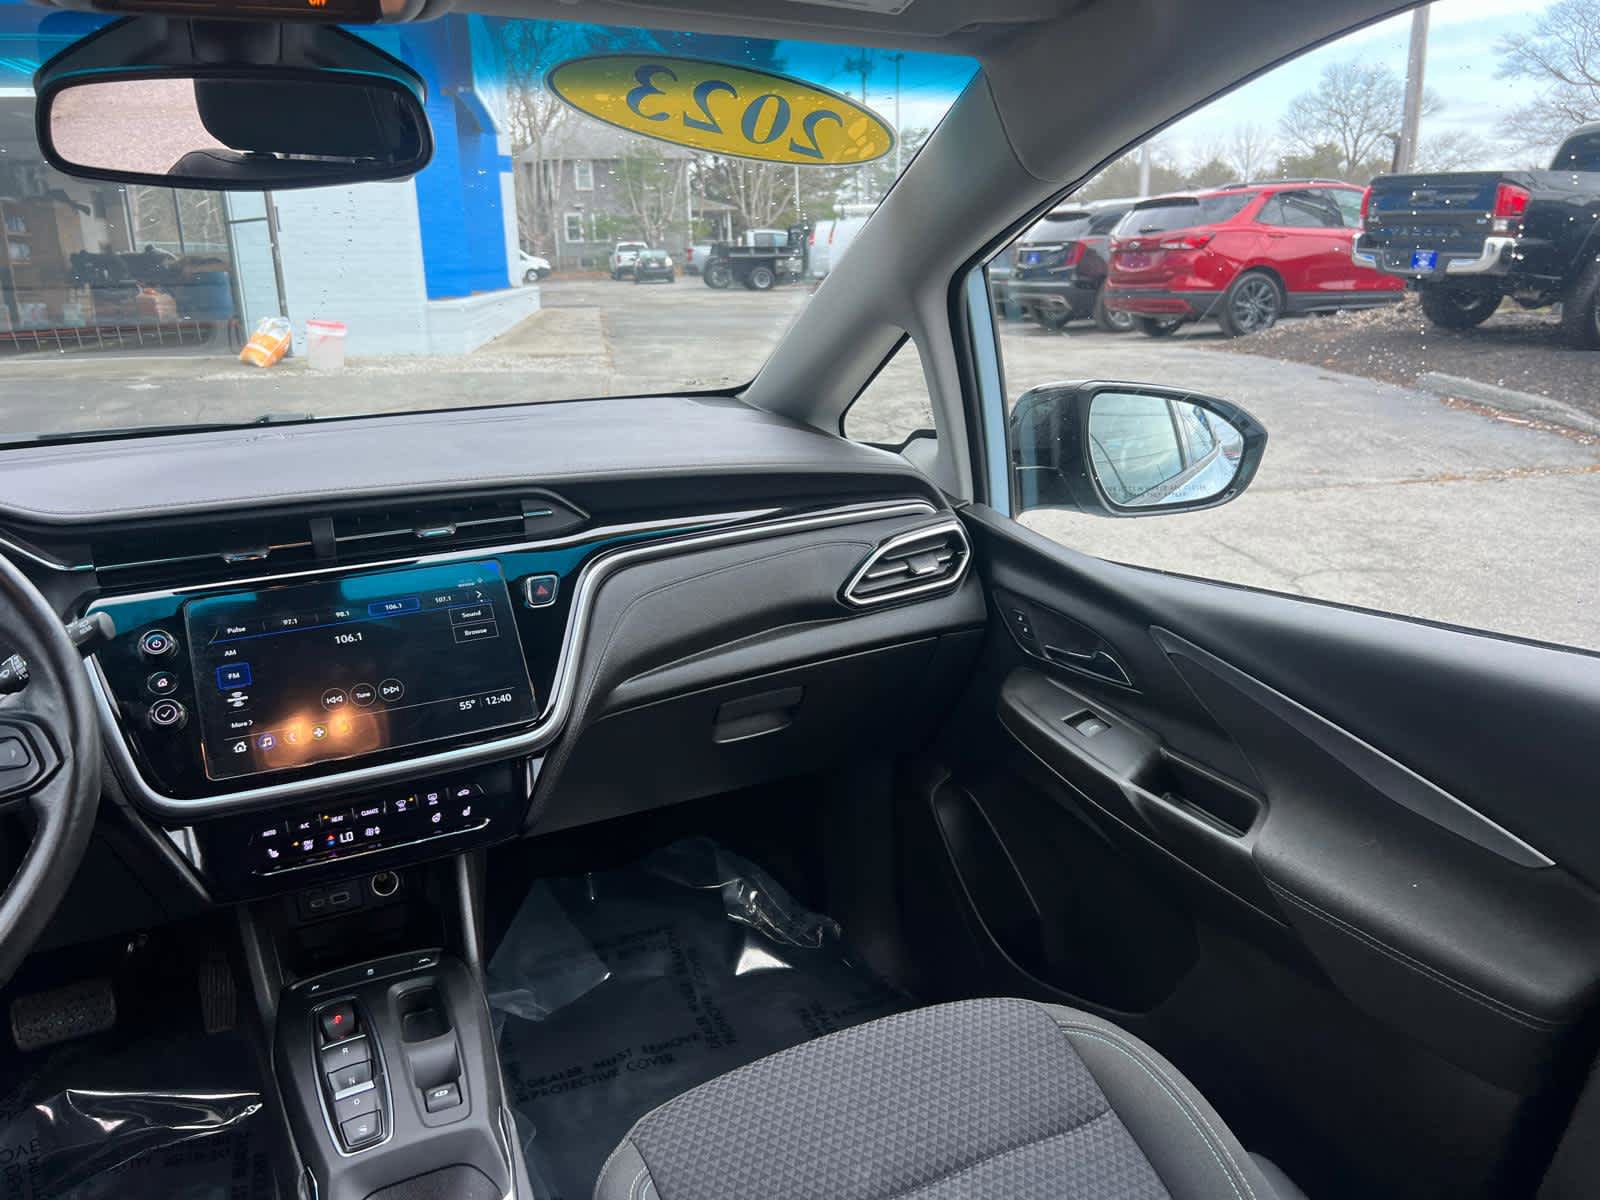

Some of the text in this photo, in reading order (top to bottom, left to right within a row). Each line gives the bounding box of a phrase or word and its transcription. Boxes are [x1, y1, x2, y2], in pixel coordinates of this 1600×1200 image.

[385, 602, 403, 611] 106.1
[461, 609, 482, 618] Sound
[226, 626, 247, 635] Pulse
[464, 628, 488, 637] Browse
[334, 631, 363, 644] 106.1
[224, 649, 237, 657] AM
[227, 672, 241, 680] FM
[356, 691, 371, 699] Tune
[458, 693, 512, 711] 55° 12:40
[231, 721, 248, 729] More
[360, 807, 380, 817] CLIMATE
[331, 815, 344, 823] HEAT
[262, 829, 278, 838] AUTO
[592, 1047, 633, 1070] MUST
[530, 1053, 677, 1099] PROTECTIVE COVER
